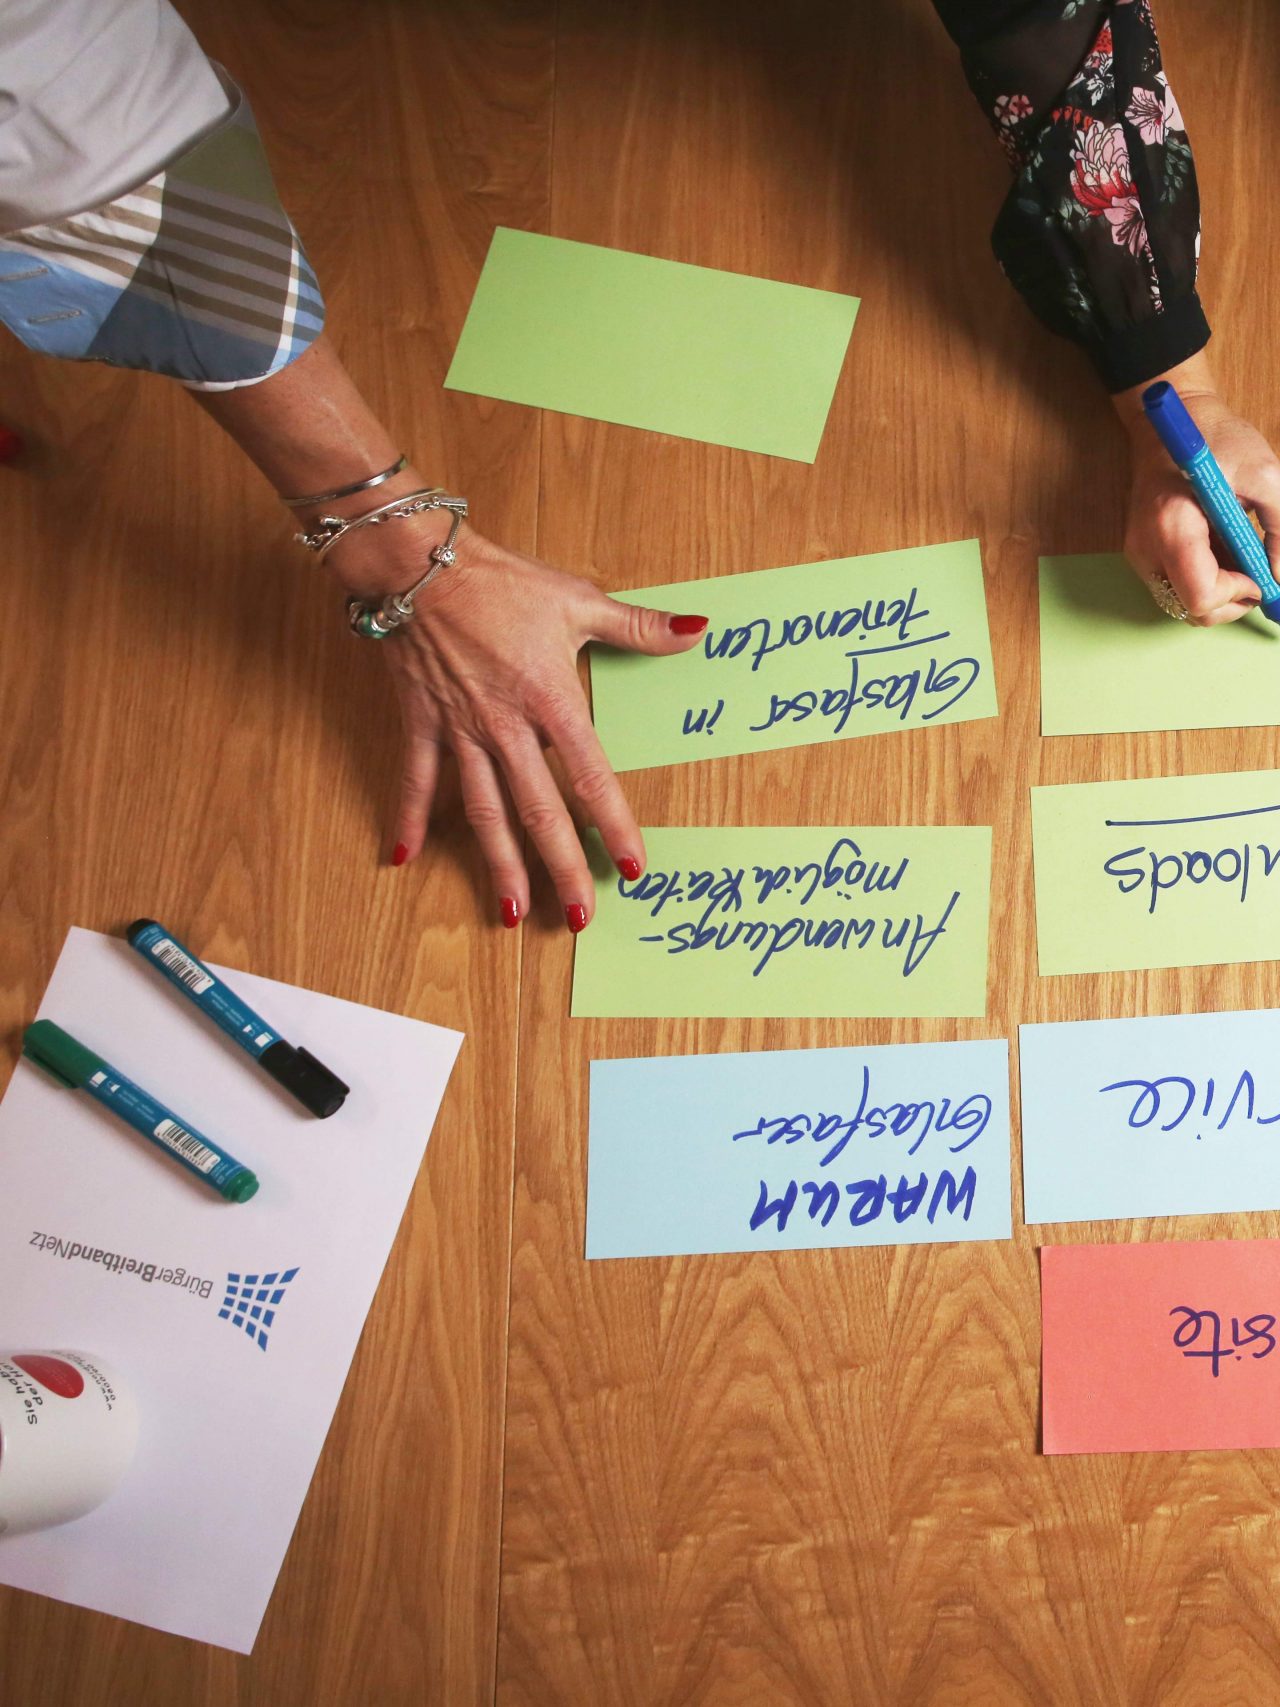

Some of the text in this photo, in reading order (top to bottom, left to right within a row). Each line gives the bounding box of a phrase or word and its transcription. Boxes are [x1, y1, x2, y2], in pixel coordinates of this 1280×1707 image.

[704, 586, 951, 672] Ferienorten
[682, 657, 981, 735] Glasfaser in
[732, 1066, 993, 1170] Glasfaser
[749, 1164, 979, 1235] WARUM
[28, 1231, 215, 1299] BürgerBreitbandNetz
[23, 1381, 43, 1406] der
[24, 1399, 38, 1425] Sie
